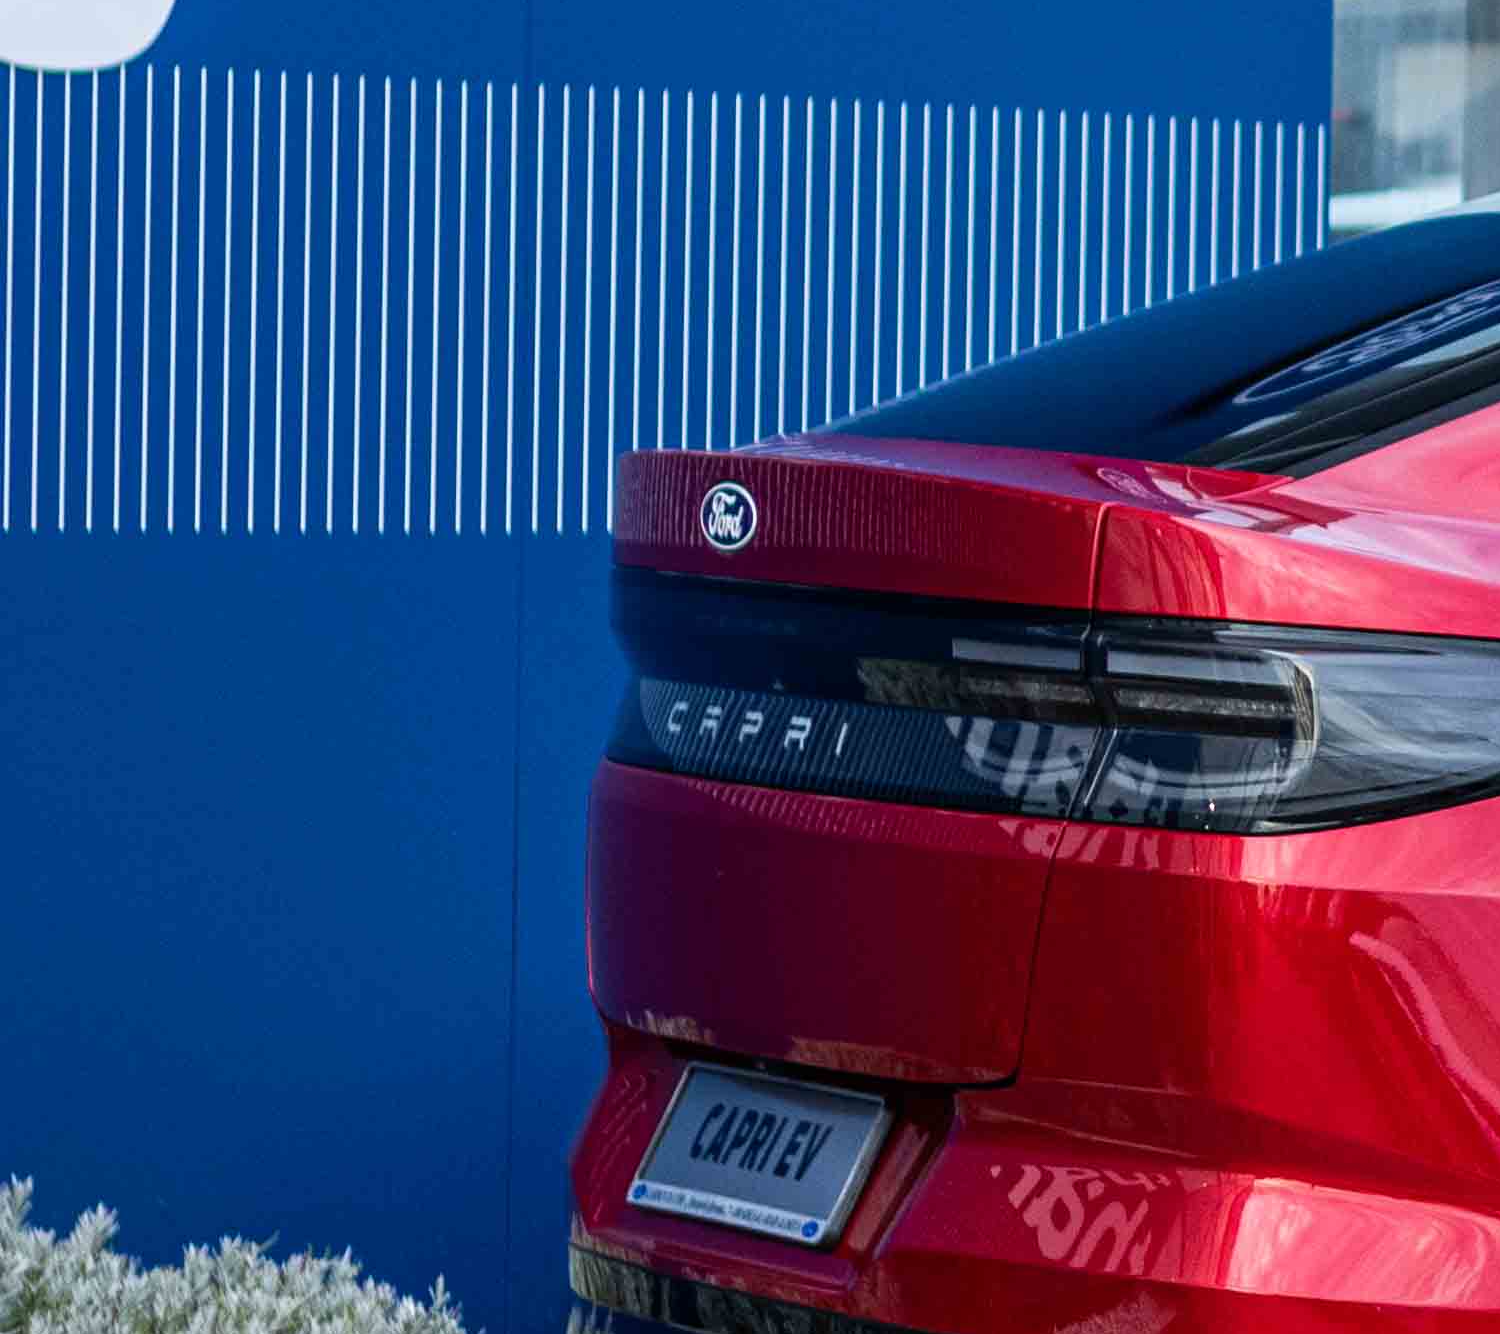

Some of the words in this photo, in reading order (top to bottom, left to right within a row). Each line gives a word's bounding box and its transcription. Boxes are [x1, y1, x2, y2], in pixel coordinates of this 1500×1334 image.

[708, 490, 745, 540] Ford
[667, 701, 849, 756] CAPRI
[689, 1102, 783, 1173] CAPRI
[772, 1119, 833, 1183] EV
